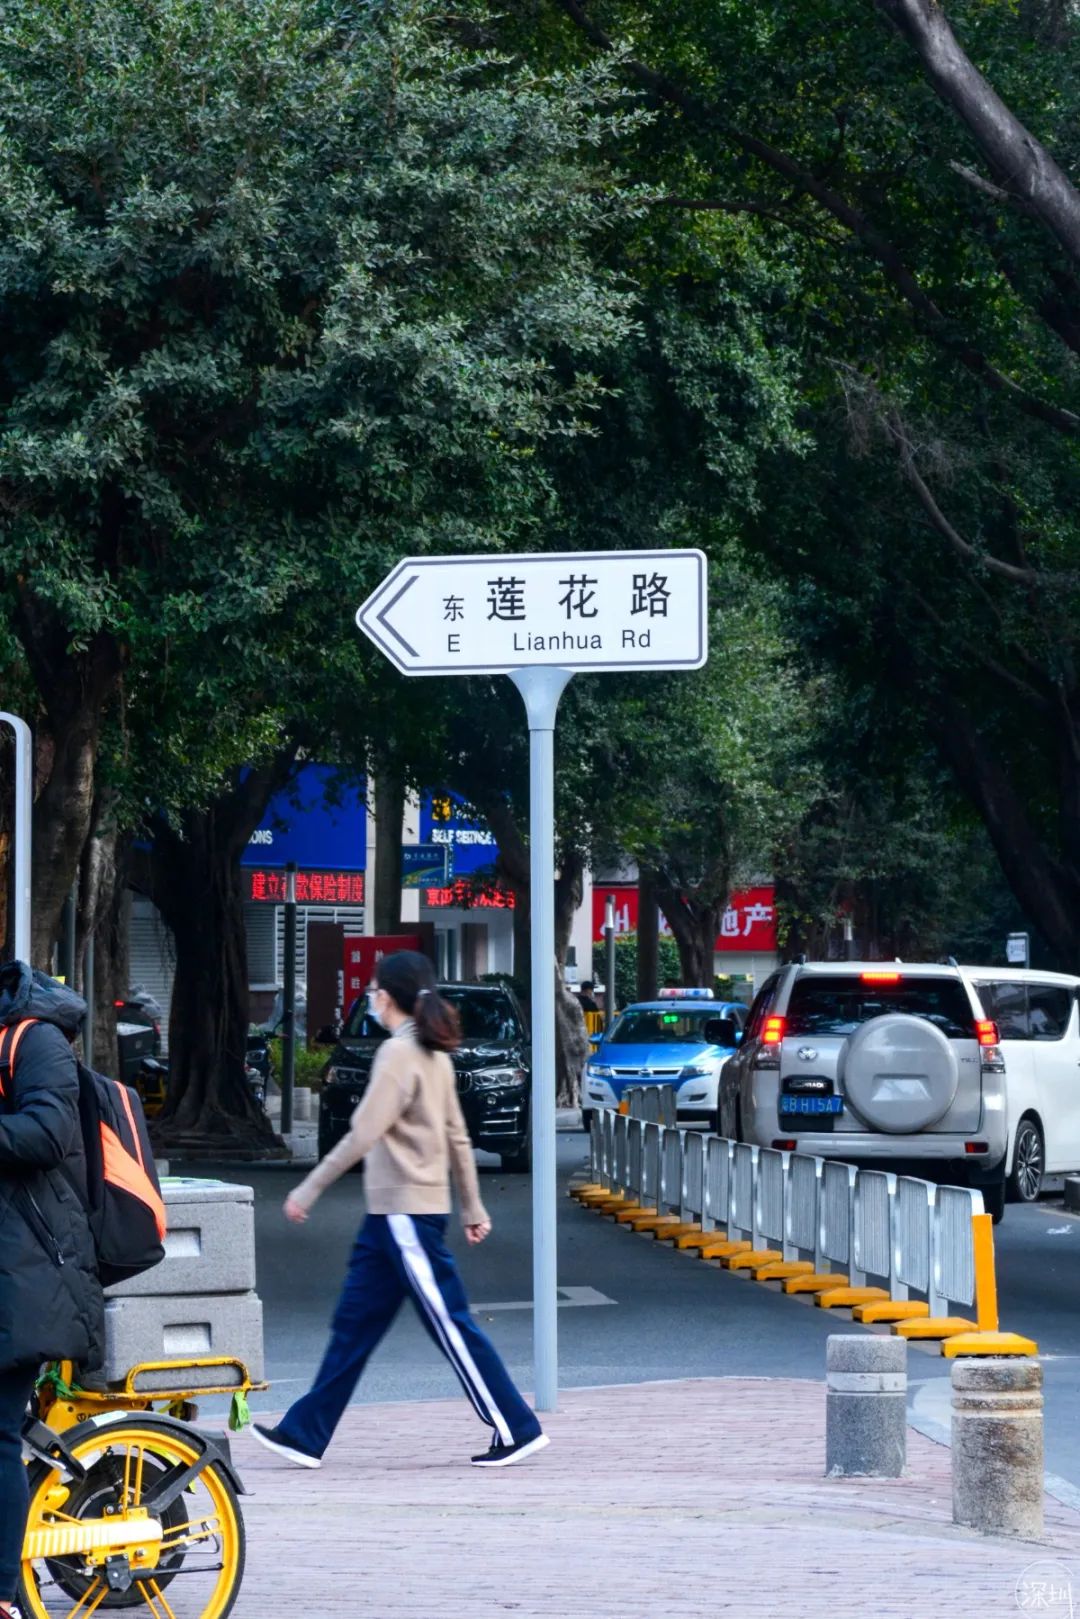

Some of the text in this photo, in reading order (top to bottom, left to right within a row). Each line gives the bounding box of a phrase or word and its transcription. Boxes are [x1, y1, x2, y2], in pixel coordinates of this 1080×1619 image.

[442, 571, 672, 622] 东 莲花路
[447, 629, 651, 652] E Lianhua Rd
